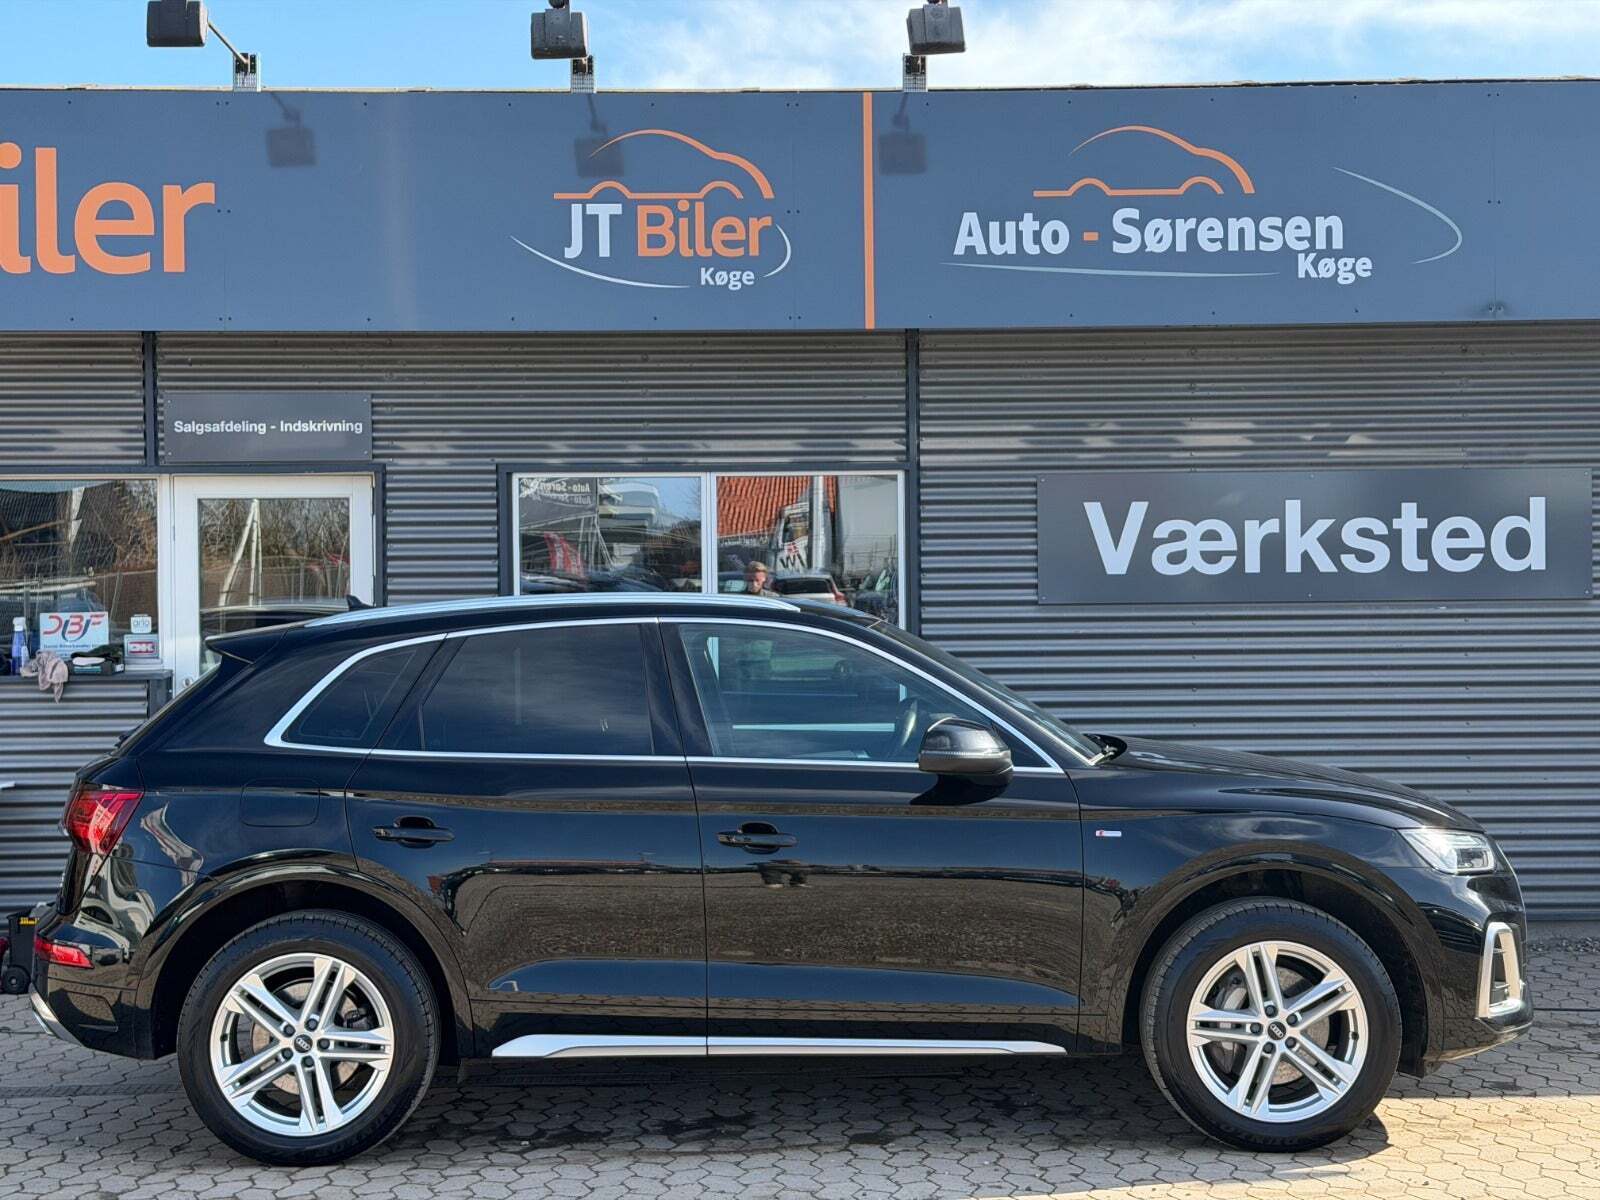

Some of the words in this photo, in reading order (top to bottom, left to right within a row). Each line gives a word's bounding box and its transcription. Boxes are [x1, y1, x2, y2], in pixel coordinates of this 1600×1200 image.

[563, 203, 623, 260] JT
[635, 199, 773, 258] Biler
[953, 212, 1070, 256] Auto
[1083, 231, 1099, 241] -
[1111, 207, 1344, 254] Sørensen
[699, 265, 756, 291] Køge
[1296, 252, 1373, 285] Køge
[174, 420, 267, 435] Salgsafdeling
[280, 420, 363, 434] Indskrivning
[1083, 496, 1547, 576] Værksted
